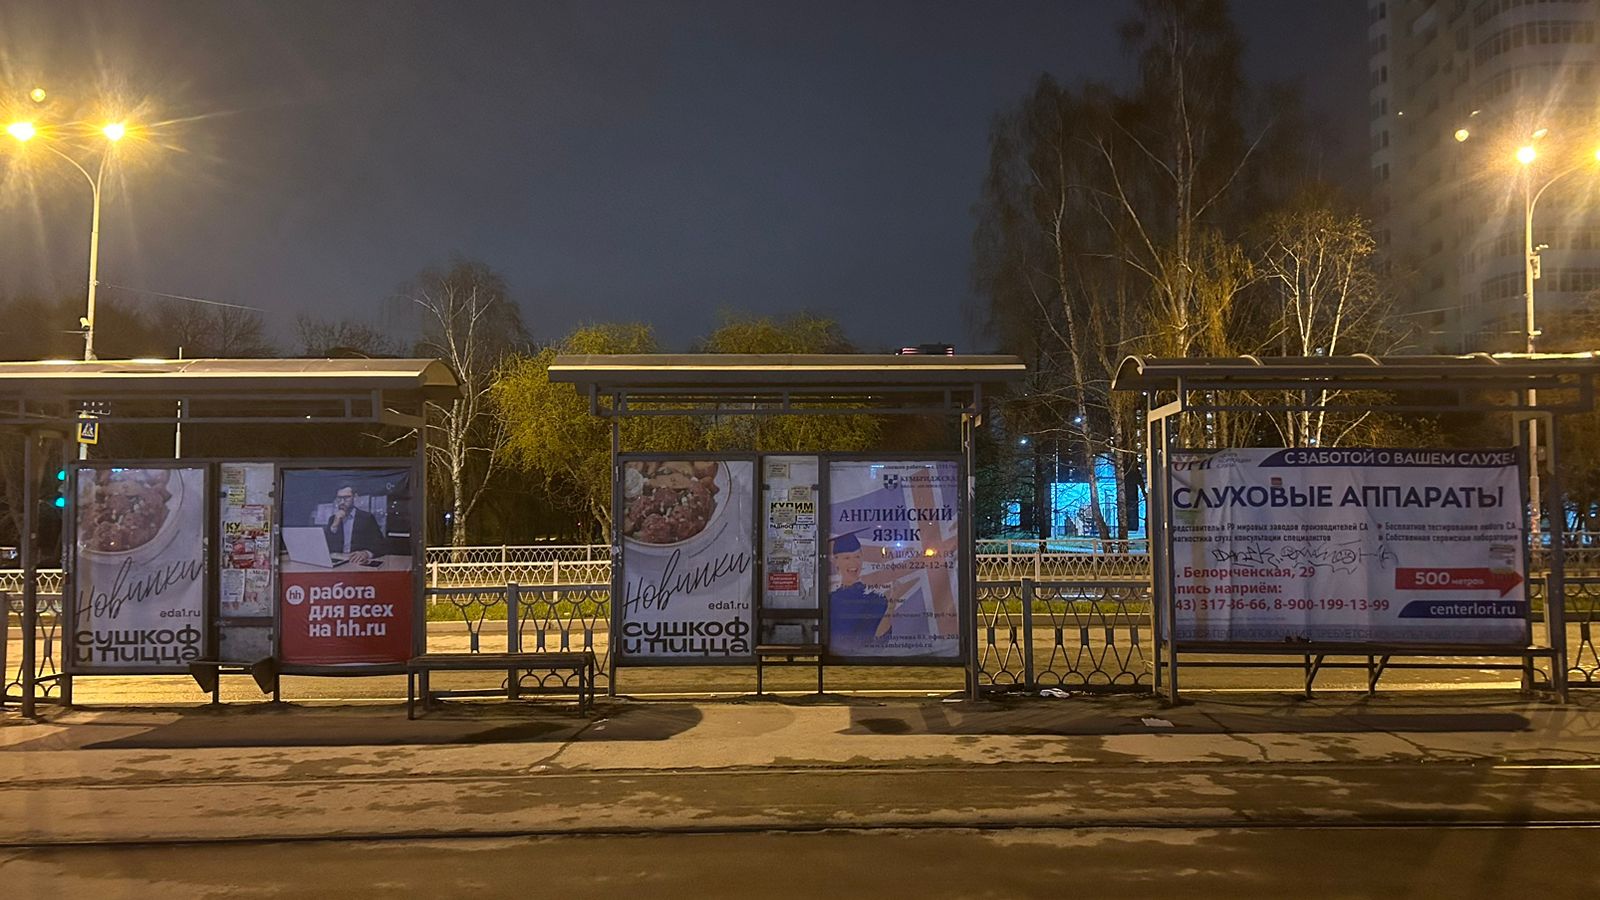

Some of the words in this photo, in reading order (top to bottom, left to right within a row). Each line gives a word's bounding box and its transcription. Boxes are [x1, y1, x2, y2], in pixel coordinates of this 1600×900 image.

[1284, 452, 1296, 464] С
[1298, 449, 1375, 464] ЗАБОТОЙ
[1378, 453, 1391, 464] О
[1394, 453, 1455, 465] ВАШЕМ
[1173, 486, 1333, 508] СЛУХОВЫЕ
[1340, 486, 1504, 508] АППАРАТЫ
[839, 505, 952, 522] АНГЛИЙСКИЙ
[872, 529, 920, 542] ЯЗЫК
[1237, 525, 1267, 533] мировых
[871, 562, 907, 571] телефон
[909, 561, 954, 569] 222-12-42
[1299, 567, 1315, 578] 29
[623, 548, 751, 619] Новинки
[1415, 572, 1450, 585] 500
[75, 556, 203, 628] Новинки
[289, 589, 302, 600] hh
[309, 582, 375, 603] работа
[309, 604, 345, 621] для
[349, 604, 394, 617] всех
[708, 600, 748, 610] eda1.ru
[1274, 599, 1390, 611] 8-900-199-13-99
[1430, 602, 1516, 616] centerlori.ru
[160, 609, 201, 618] eda1.ru
[309, 623, 331, 637] на
[336, 620, 386, 637] hh.ru
[623, 617, 749, 641] сушкоф
[75, 625, 202, 650] сушкоф
[623, 638, 641, 654] и
[644, 637, 750, 656] пицца
[77, 647, 93, 662] и
[97, 646, 200, 664] пицца
